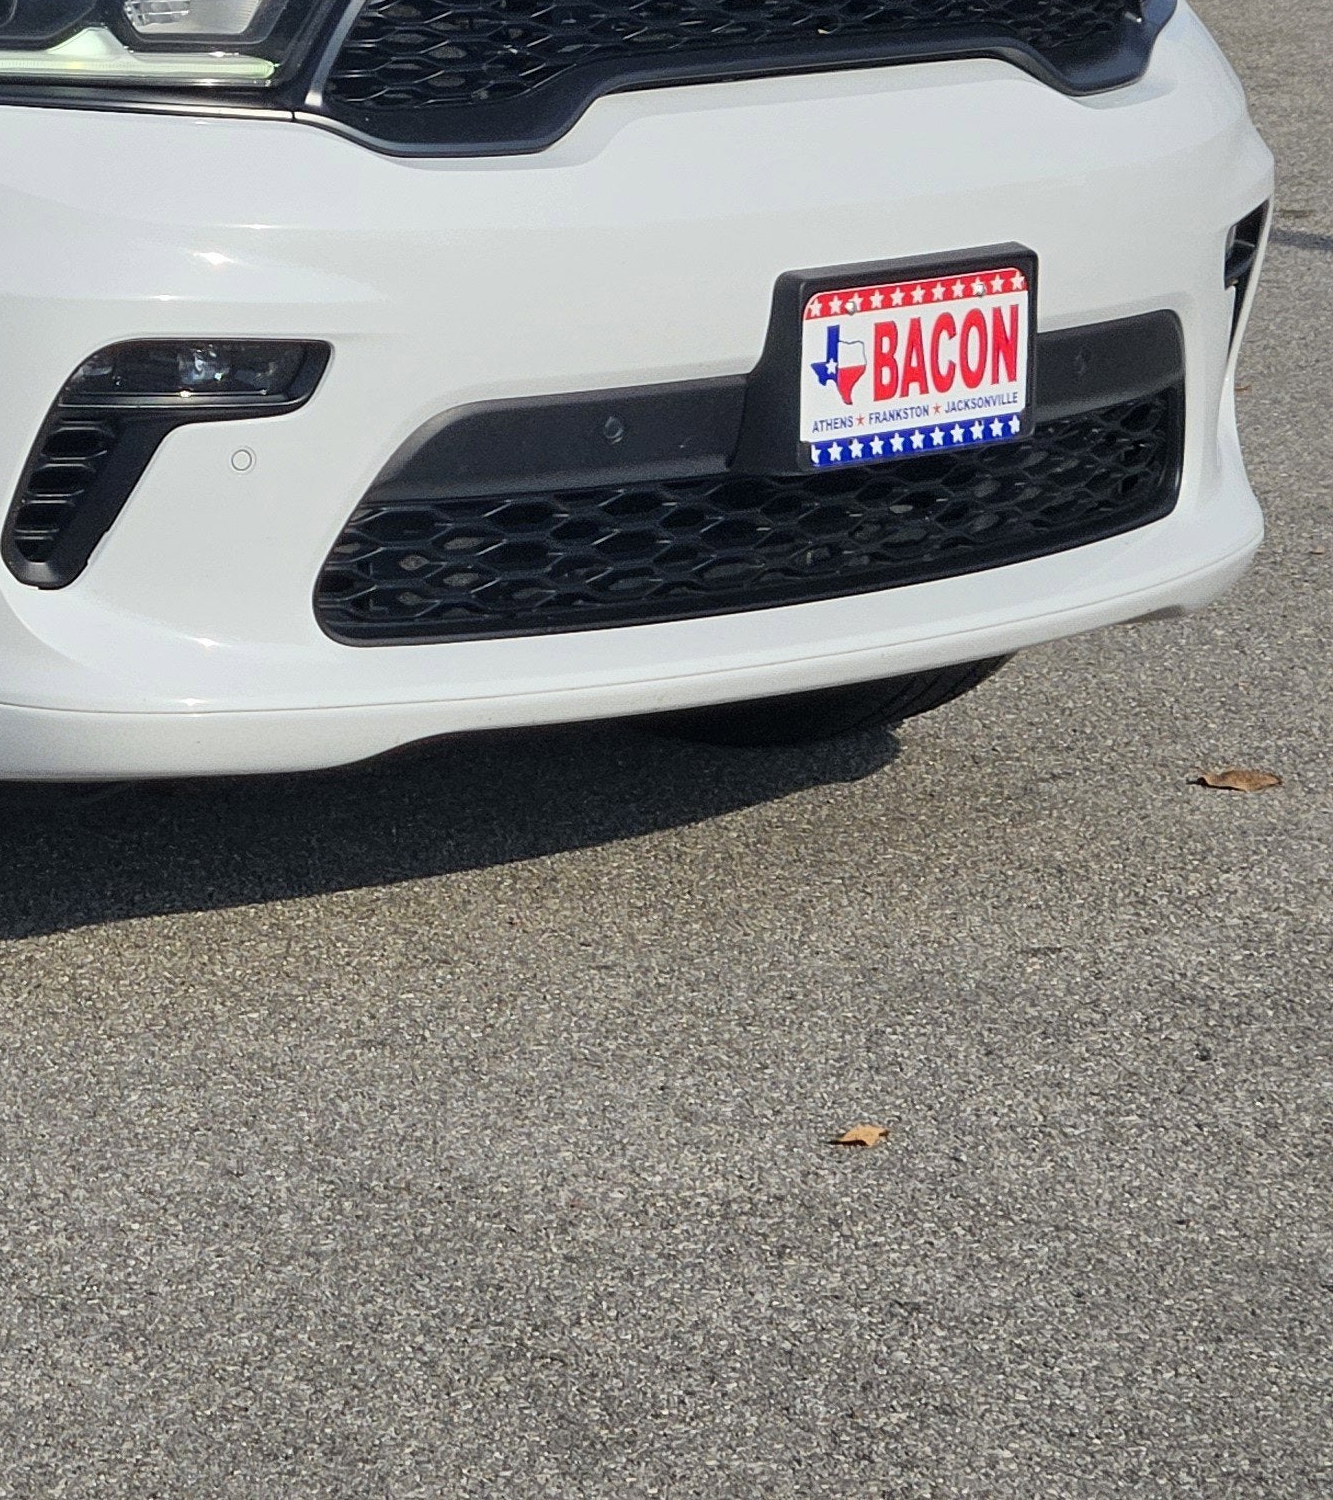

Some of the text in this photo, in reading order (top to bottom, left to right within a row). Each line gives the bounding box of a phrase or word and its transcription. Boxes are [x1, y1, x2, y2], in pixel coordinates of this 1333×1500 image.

[873, 304, 1020, 402] BACON
[812, 391, 1019, 433] ATHENS FRANKSTON JACKSONVILLE
